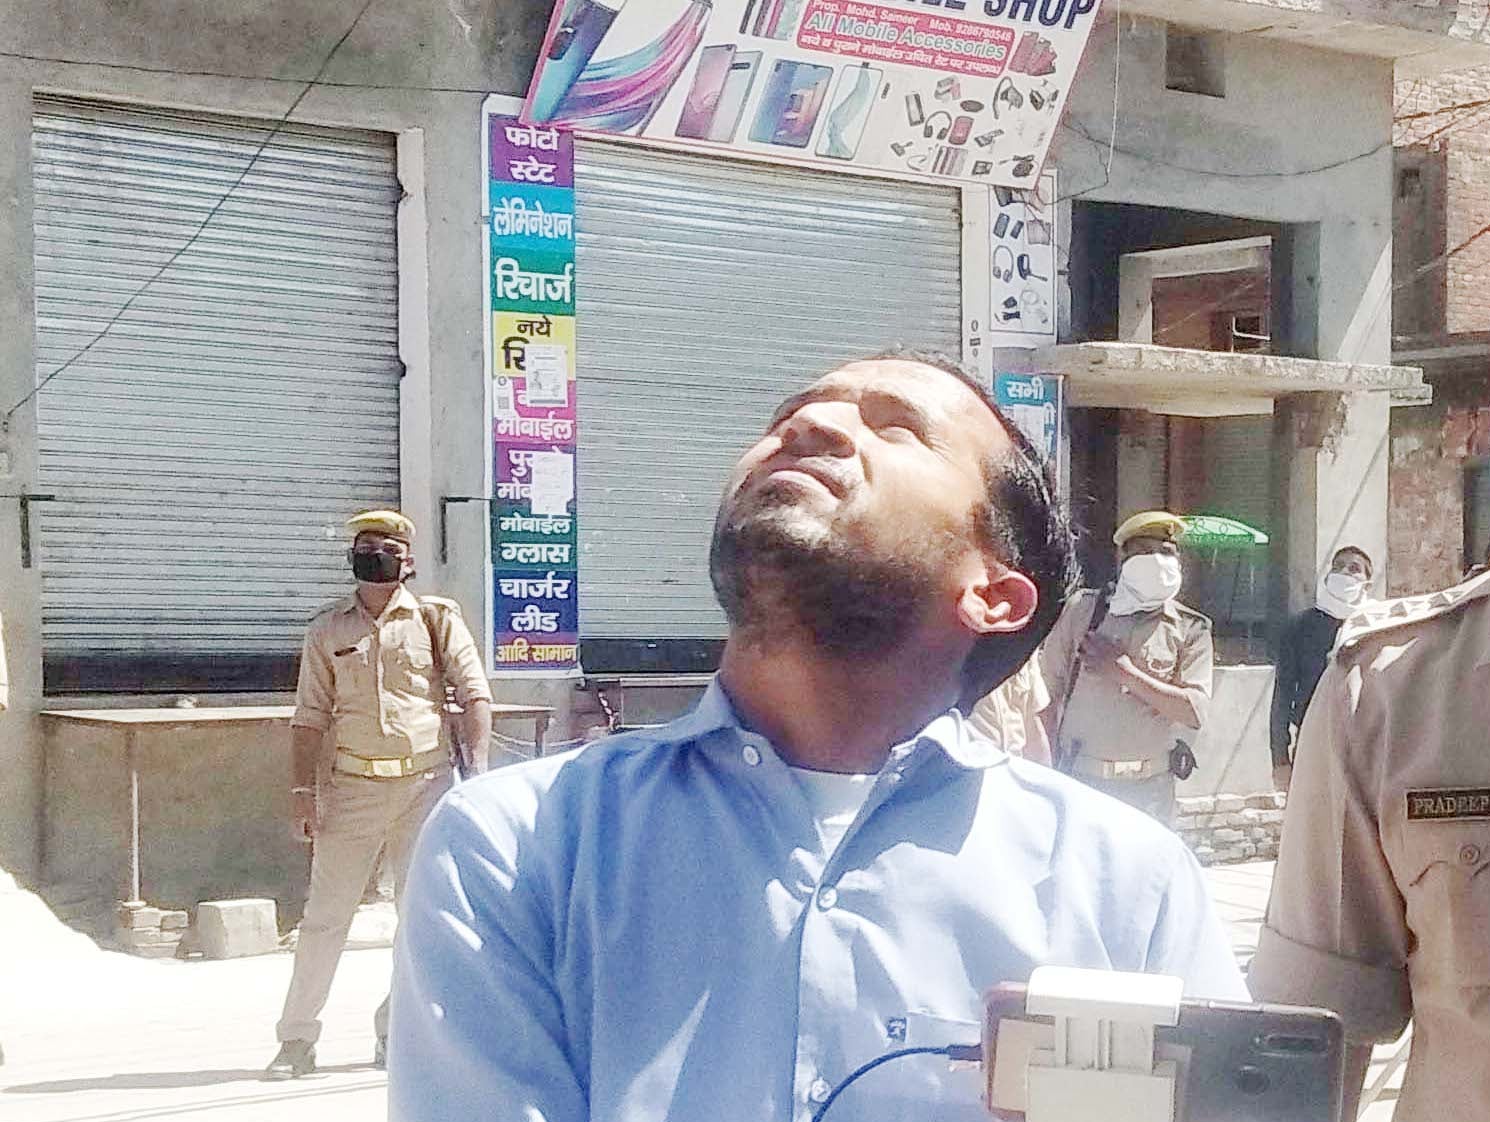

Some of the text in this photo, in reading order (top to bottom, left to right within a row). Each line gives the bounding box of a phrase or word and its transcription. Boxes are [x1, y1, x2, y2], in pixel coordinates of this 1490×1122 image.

[805, 11, 1005, 60] All Mobile Accessories
[504, 125, 560, 152] फोटो
[509, 156, 557, 183] स्टेट
[494, 257, 574, 303] रिचार्ज
[516, 315, 553, 338] नये
[1006, 376, 1044, 400] सभी
[501, 542, 570, 564] ग्लास
[499, 572, 571, 600] चार्जर
[511, 606, 560, 633] लीड
[496, 638, 577, 664] आदि सामान
